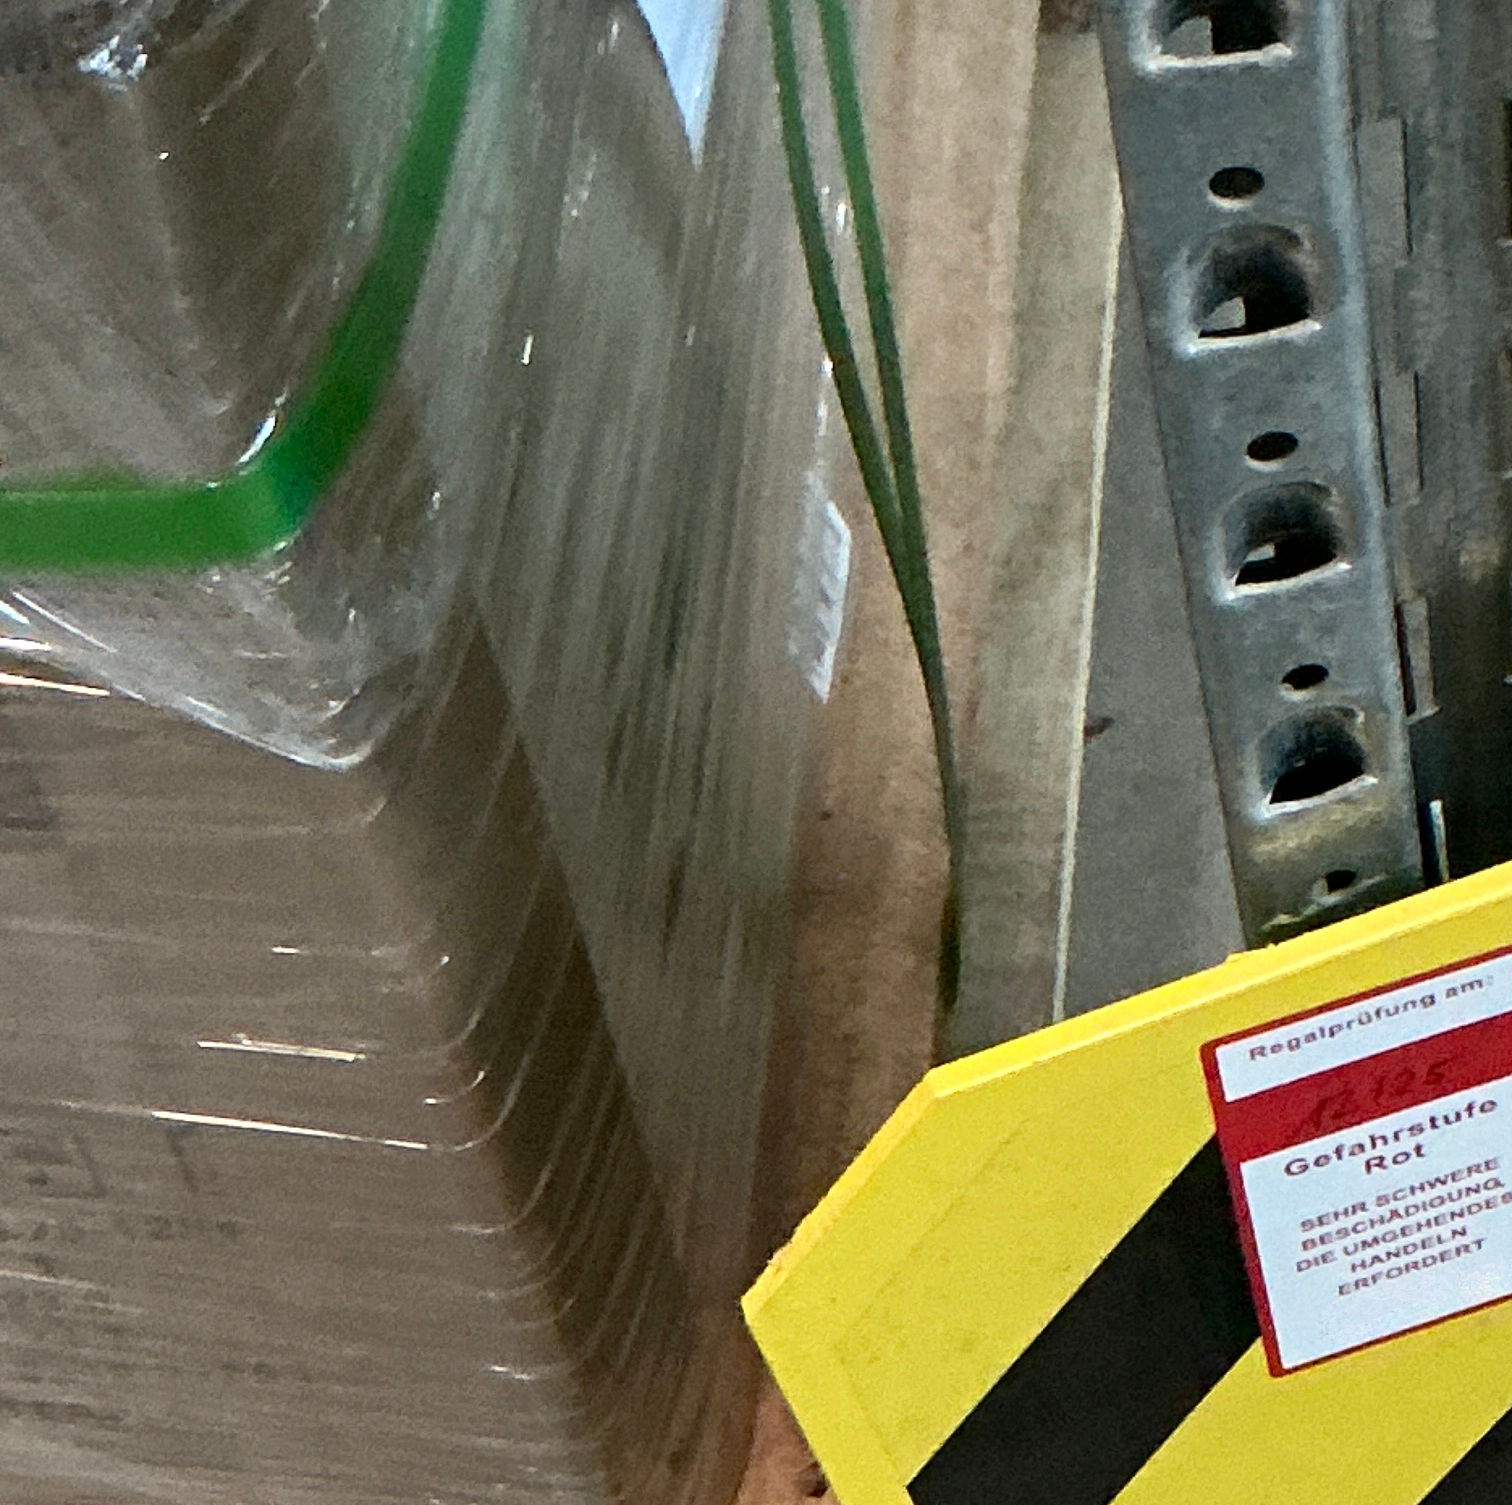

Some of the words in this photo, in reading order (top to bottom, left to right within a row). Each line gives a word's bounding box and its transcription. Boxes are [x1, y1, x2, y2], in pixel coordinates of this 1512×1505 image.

[1249, 992, 1437, 1061] Regalprüfung
[1284, 1099, 1499, 1177] Gefahrstufe
[1365, 1142, 1426, 1176] Rot
[1300, 1201, 1369, 1233] SEHR
[1375, 1156, 1501, 1208] SCHWERE
[1296, 1250, 1337, 1273] DIE
[1338, 1237, 1487, 1296] ERFORDERT
[1350, 1225, 1468, 1273] HANDELN
